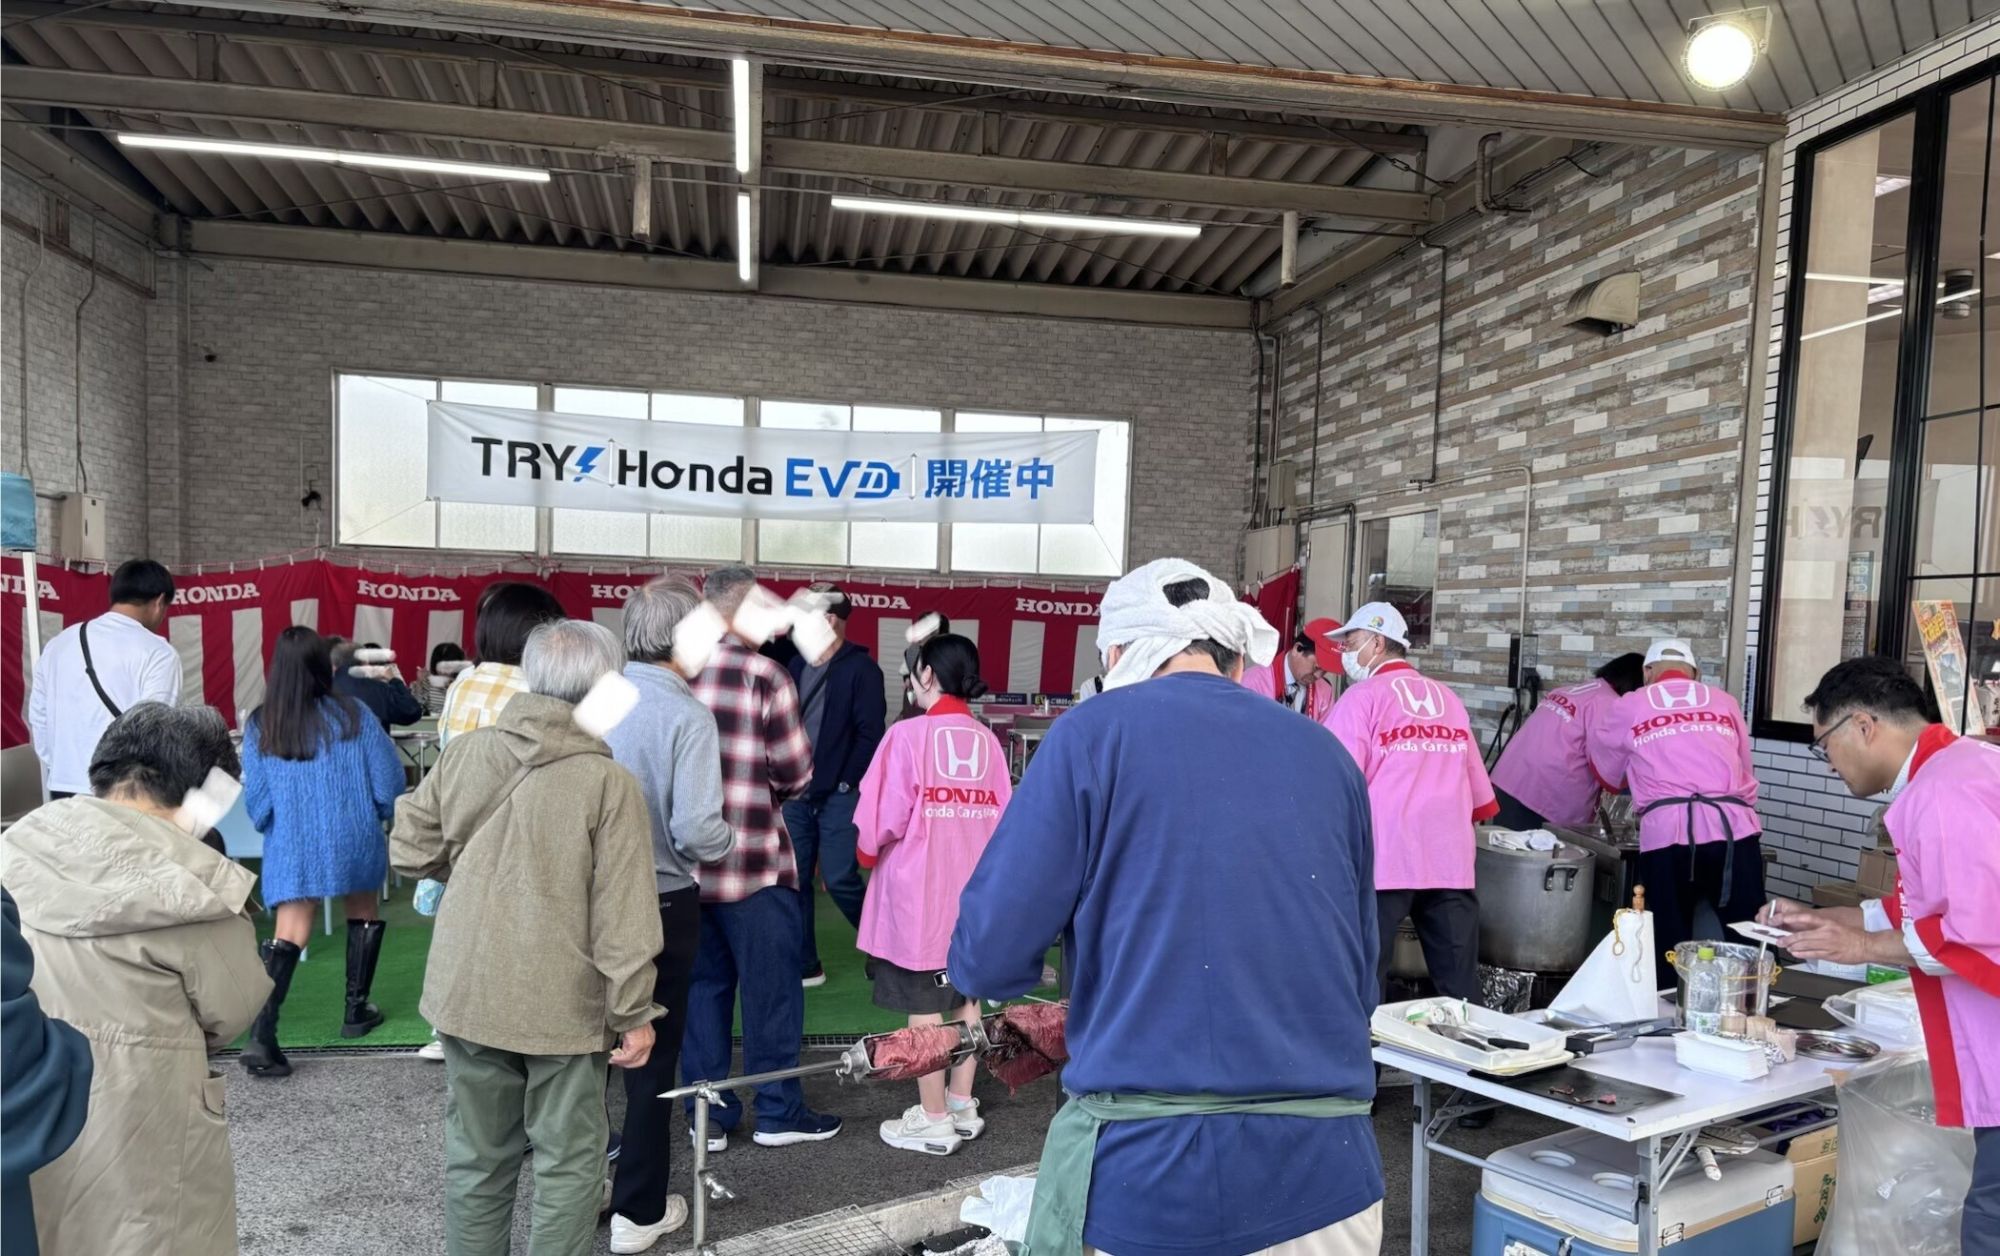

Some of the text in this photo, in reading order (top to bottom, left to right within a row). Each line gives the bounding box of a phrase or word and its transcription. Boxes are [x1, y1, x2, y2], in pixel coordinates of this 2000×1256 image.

[471, 436, 577, 481] TRY
[617, 449, 773, 496] Honda
[925, 457, 1055, 499] 開催中
[1, 573, 60, 600] NDA
[170, 582, 260, 605] HONDA
[357, 579, 461, 602] HONDA
[846, 592, 911, 610] NDA
[1379, 724, 1469, 746] HONDA
[1631, 711, 1735, 738] HONDA
[1633, 727, 1677, 748] Honda
[1680, 723, 1713, 733] Cars
[1422, 740, 1449, 752] Cars
[924, 787, 1000, 806] HONDA
[923, 805, 955, 818] onda
